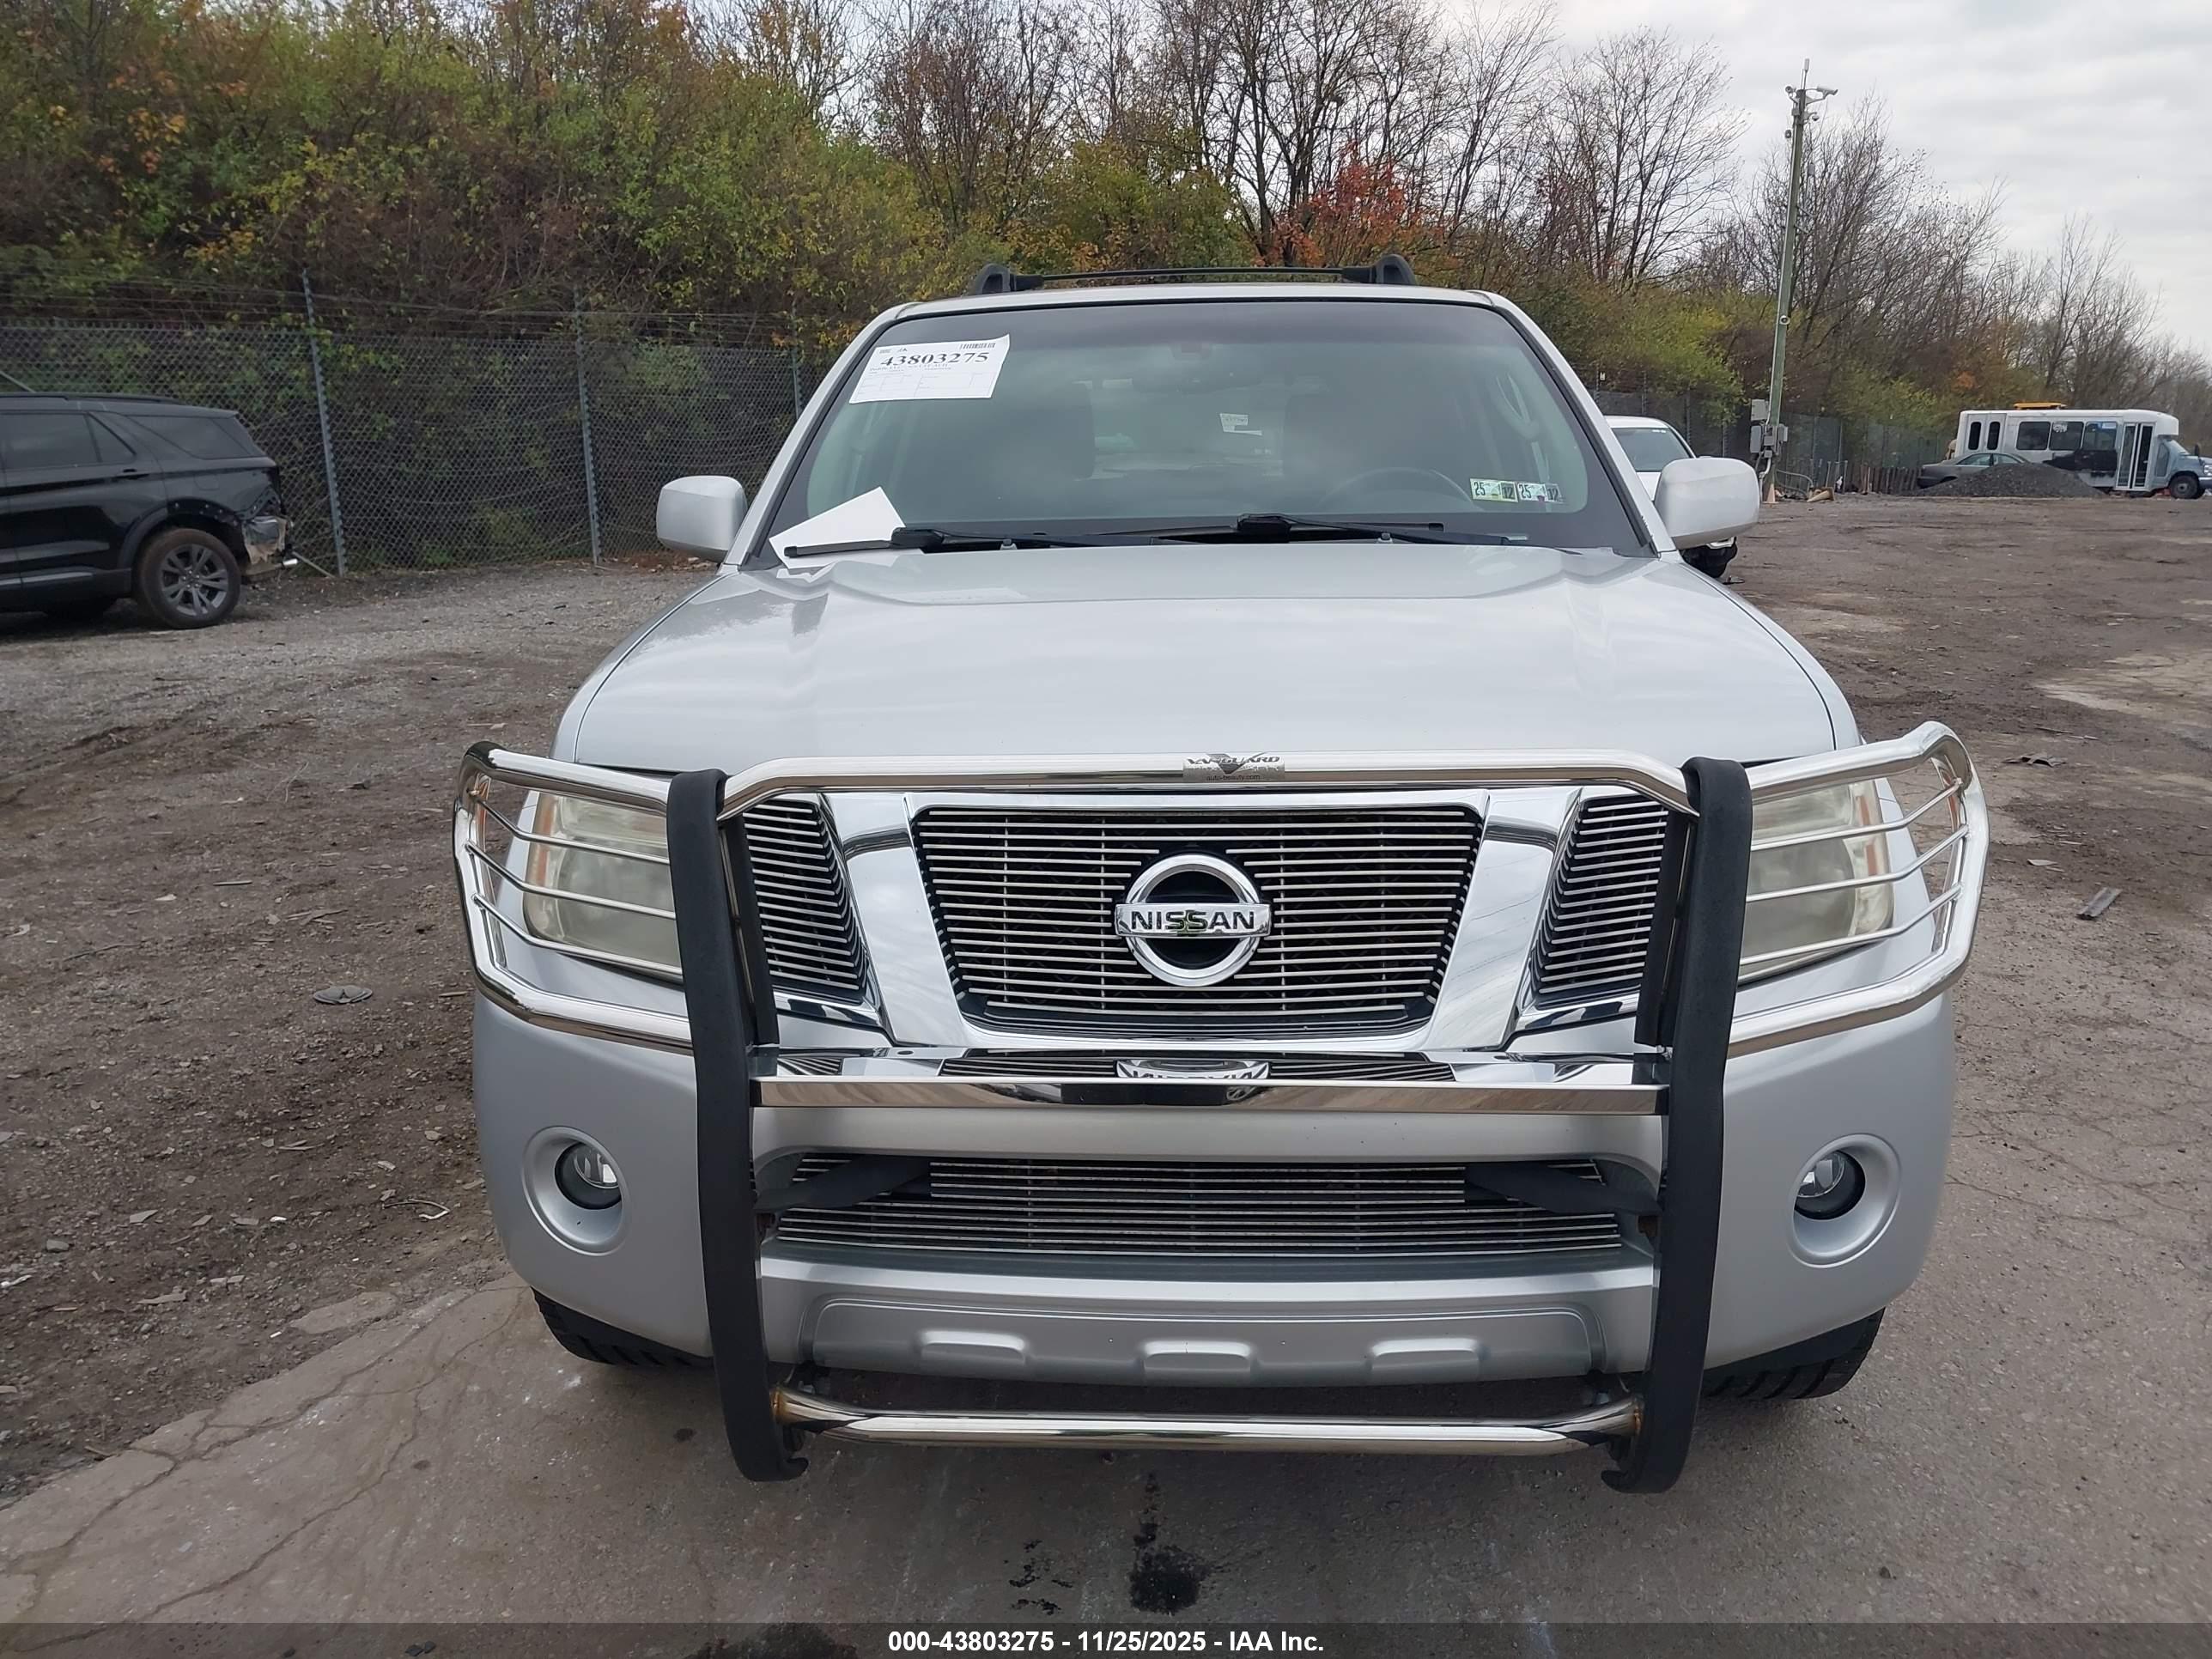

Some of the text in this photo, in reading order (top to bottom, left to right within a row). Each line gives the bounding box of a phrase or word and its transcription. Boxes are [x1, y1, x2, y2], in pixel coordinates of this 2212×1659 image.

[880, 352, 989, 366] 43803275
[1474, 482, 1486, 496] 25
[1502, 486, 1515, 500] 12
[1518, 483, 1532, 499] 25
[1131, 910, 1255, 930] NISSAN
